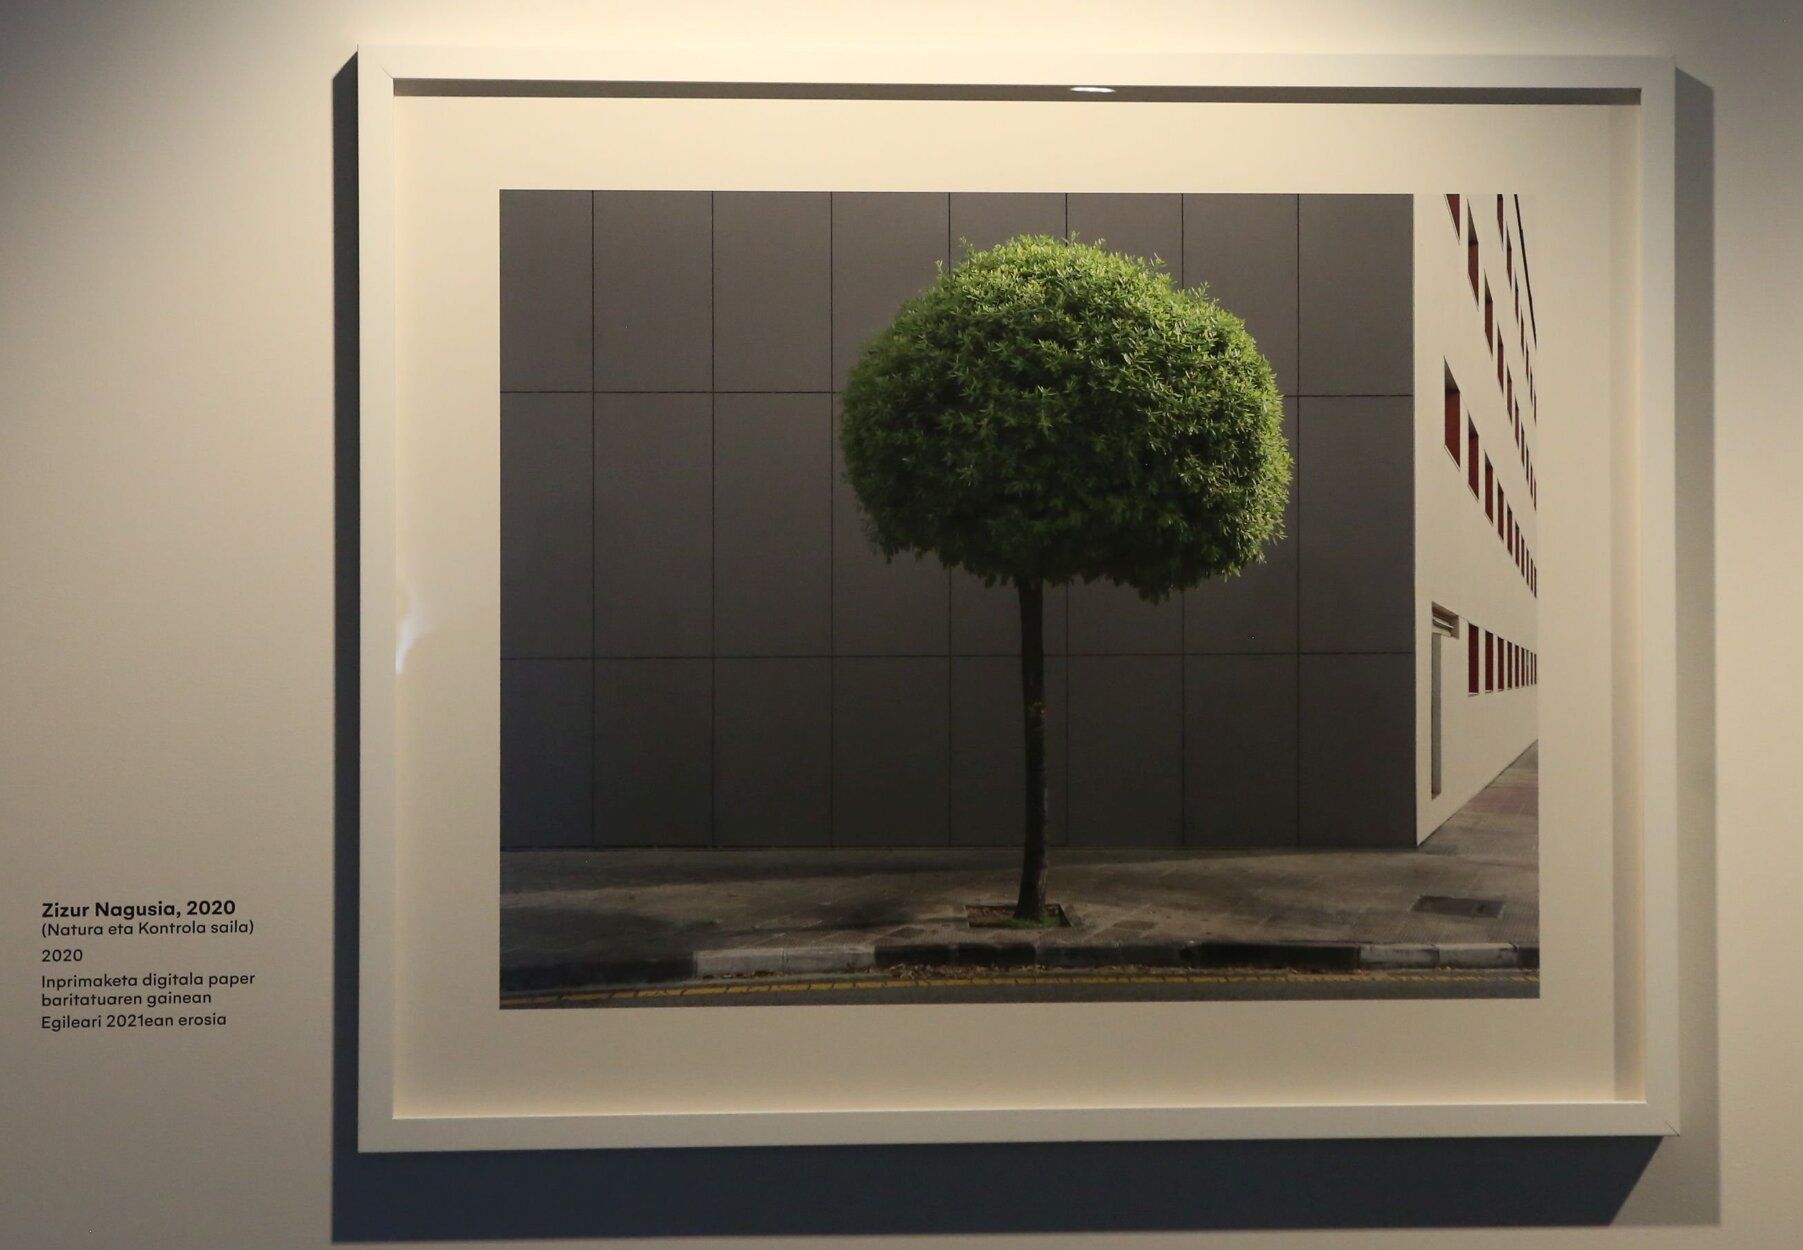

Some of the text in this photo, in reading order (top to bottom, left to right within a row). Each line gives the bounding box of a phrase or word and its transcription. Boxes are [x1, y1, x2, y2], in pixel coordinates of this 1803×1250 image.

[42, 900, 236, 920] Zizur Nagusia, 2020
[41, 919, 254, 938] (Natura eta Kontrola saila)
[41, 949, 83, 962] 2020
[41, 972, 256, 991] Inprimaketa digitala paper
[41, 992, 212, 1008] baritatuaren gainean
[41, 1012, 227, 1032] Egileari 2021ean erosia
